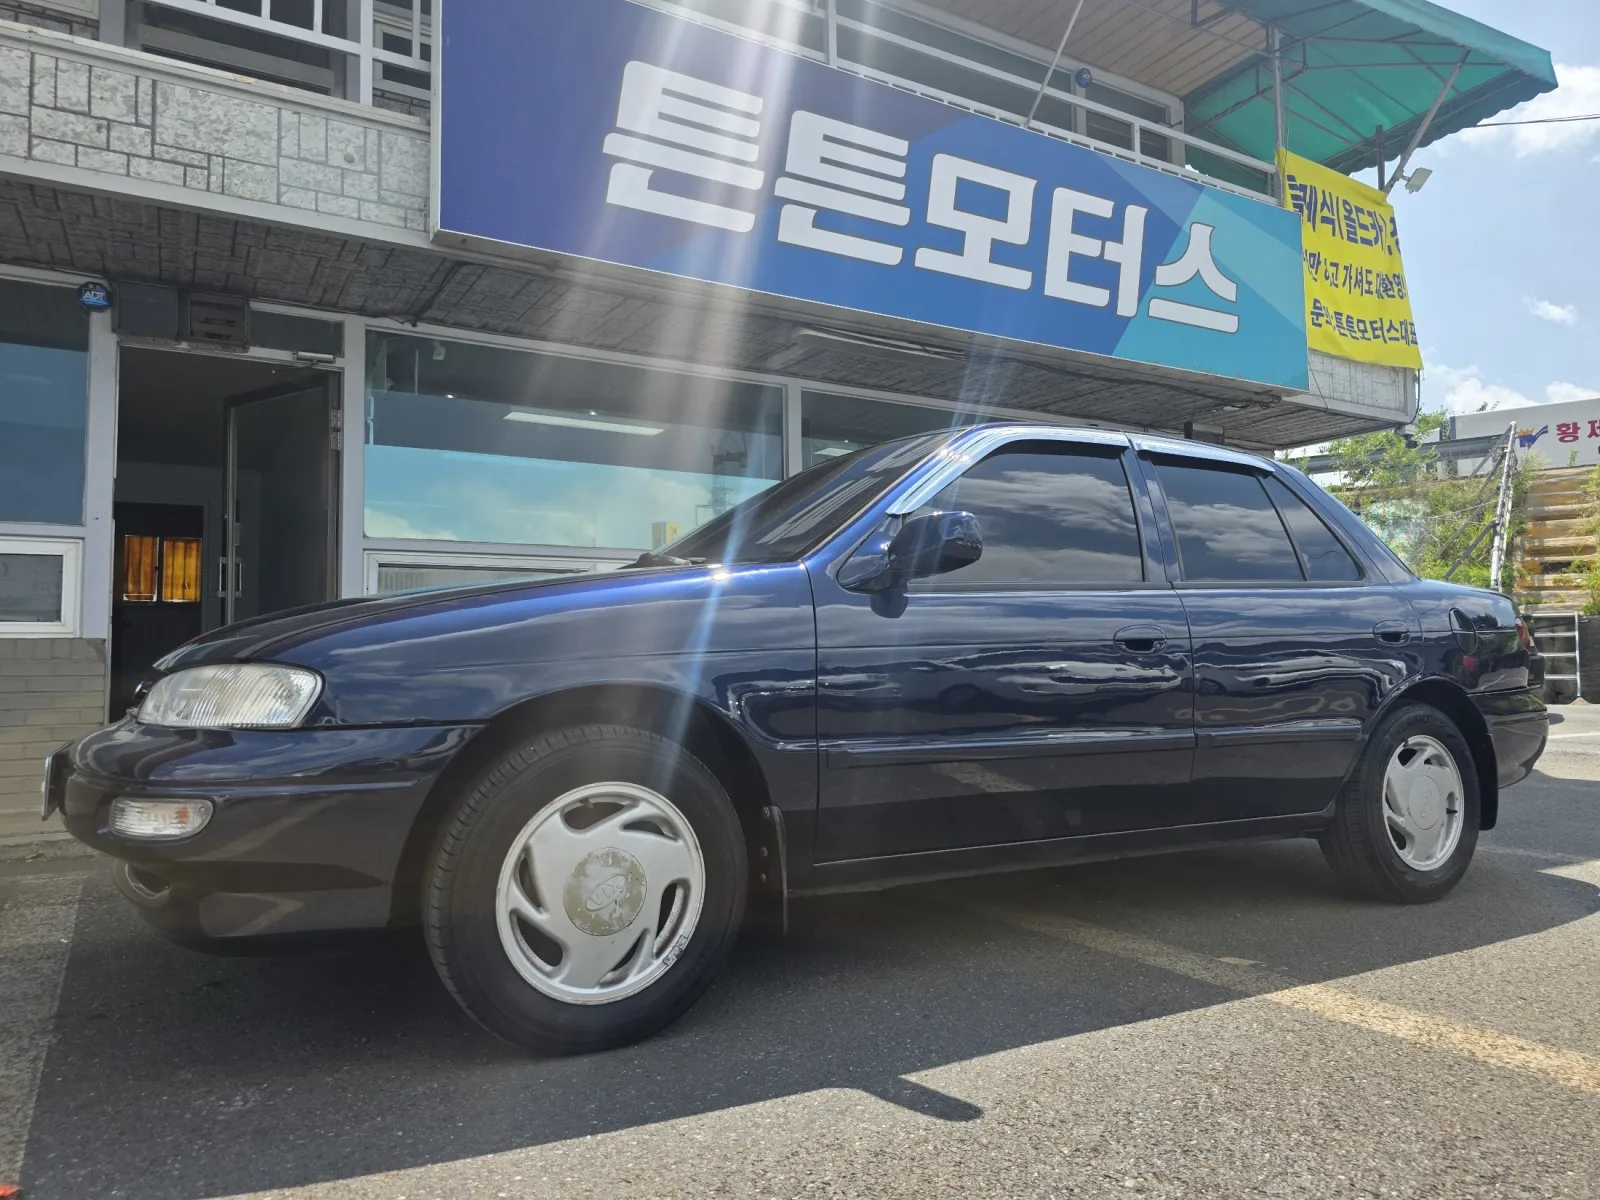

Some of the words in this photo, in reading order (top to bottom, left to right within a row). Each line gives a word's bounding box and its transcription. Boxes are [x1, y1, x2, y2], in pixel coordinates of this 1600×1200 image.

[602, 60, 1240, 335] 튼튼모터스
[1303, 249, 1322, 283] 만
[82, 290, 106, 301] ADT
